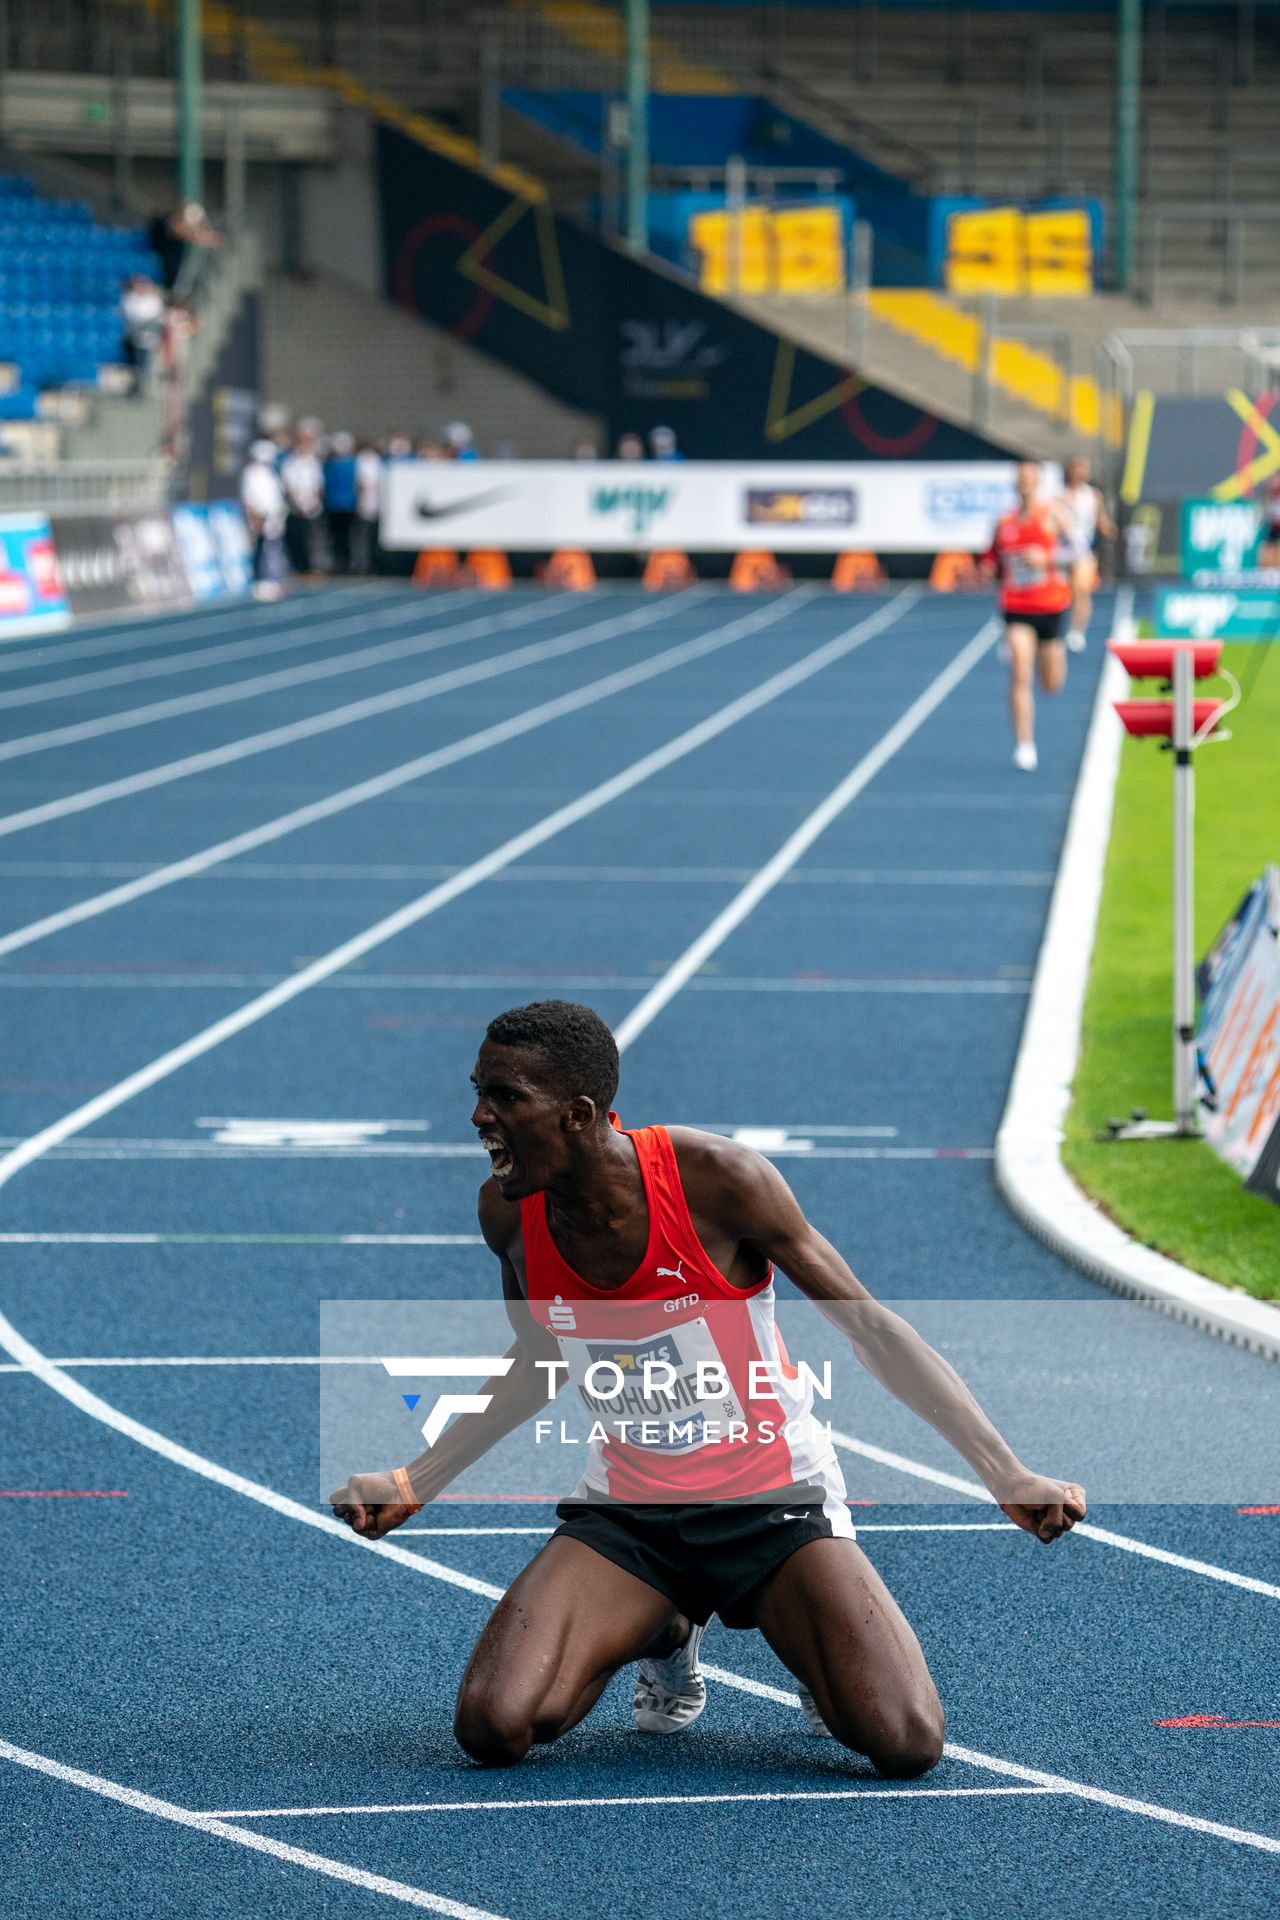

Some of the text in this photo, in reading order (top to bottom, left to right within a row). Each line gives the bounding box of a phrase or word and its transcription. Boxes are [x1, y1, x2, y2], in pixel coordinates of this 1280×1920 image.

[663, 1292, 700, 1313] GfTD
[577, 1366, 724, 1416] MOHUMED
[722, 1400, 737, 1418] 236
